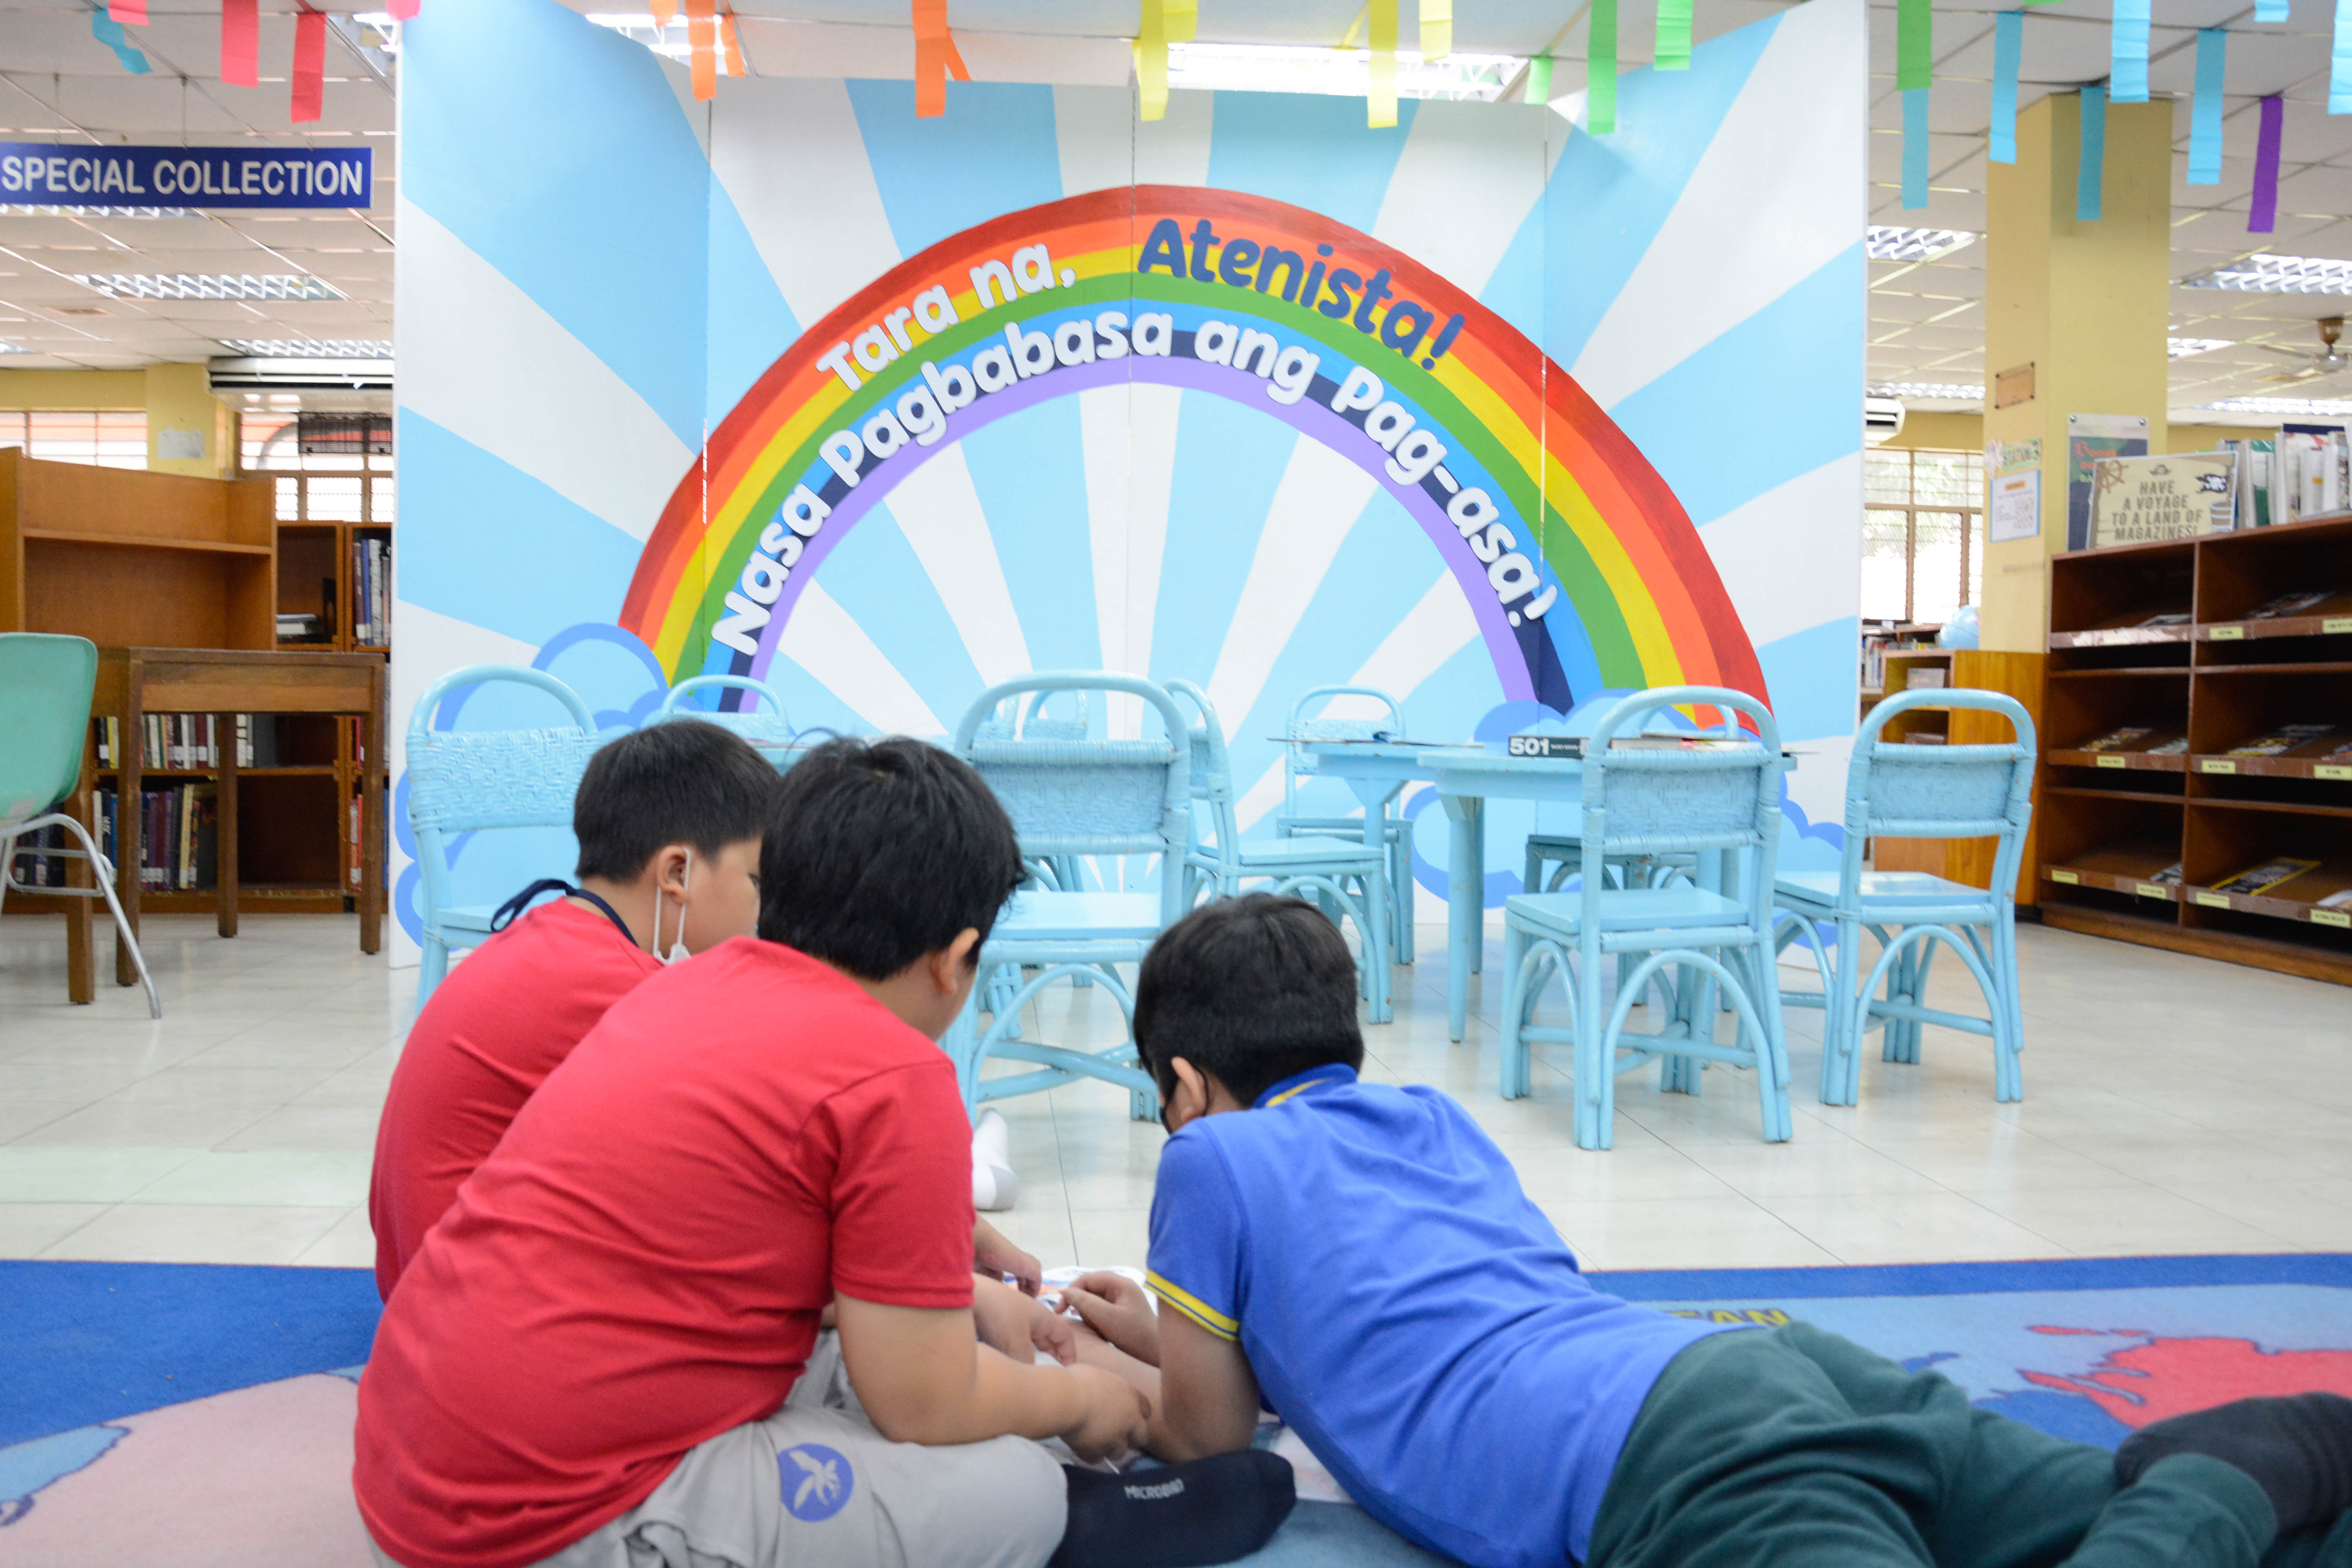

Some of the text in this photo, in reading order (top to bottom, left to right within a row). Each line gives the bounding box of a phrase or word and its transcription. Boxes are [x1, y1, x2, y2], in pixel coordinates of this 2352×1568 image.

[2, 156, 363, 196] SPECIAL COLLECTION
[815, 218, 1465, 392] Tara na, Atenista!
[711, 310, 1558, 657] Nasa Pagbabasa ang Pag-asa!
[2139, 480, 2175, 495] HAVE
[2123, 494, 2189, 511] A VOYAGE
[2112, 508, 2203, 526] TO A LAND OF
[1509, 737, 1549, 755] 501
